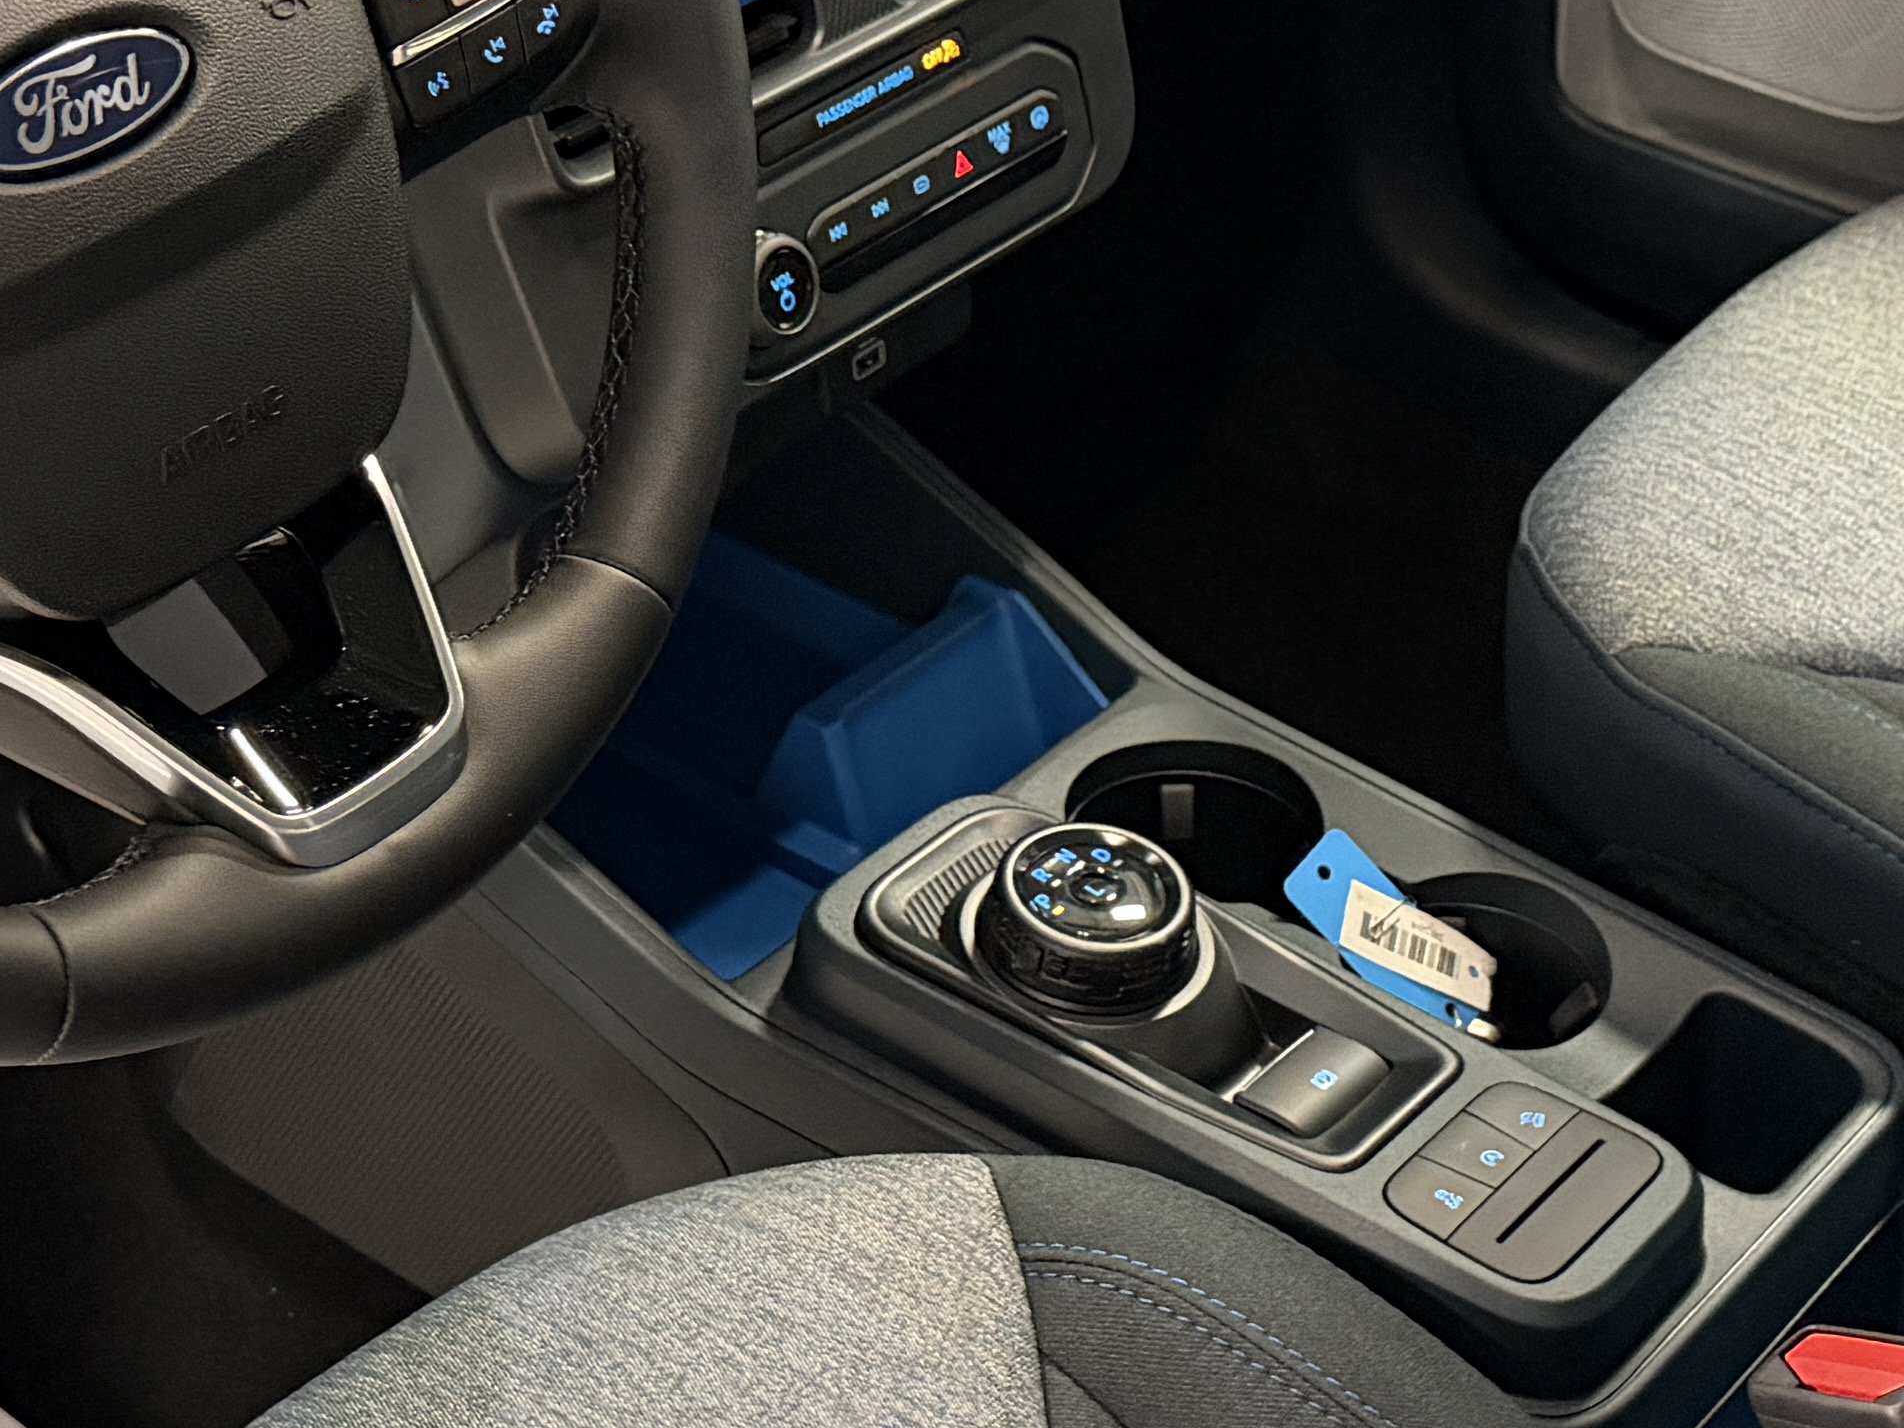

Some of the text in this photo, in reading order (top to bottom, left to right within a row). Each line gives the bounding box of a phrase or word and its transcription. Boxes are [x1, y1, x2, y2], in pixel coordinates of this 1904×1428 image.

[14, 52, 151, 155] Ford
[770, 272, 795, 292] VOL
[1055, 848, 1077, 864] N
[1091, 848, 1112, 864] D
[1031, 868, 1053, 883] R
